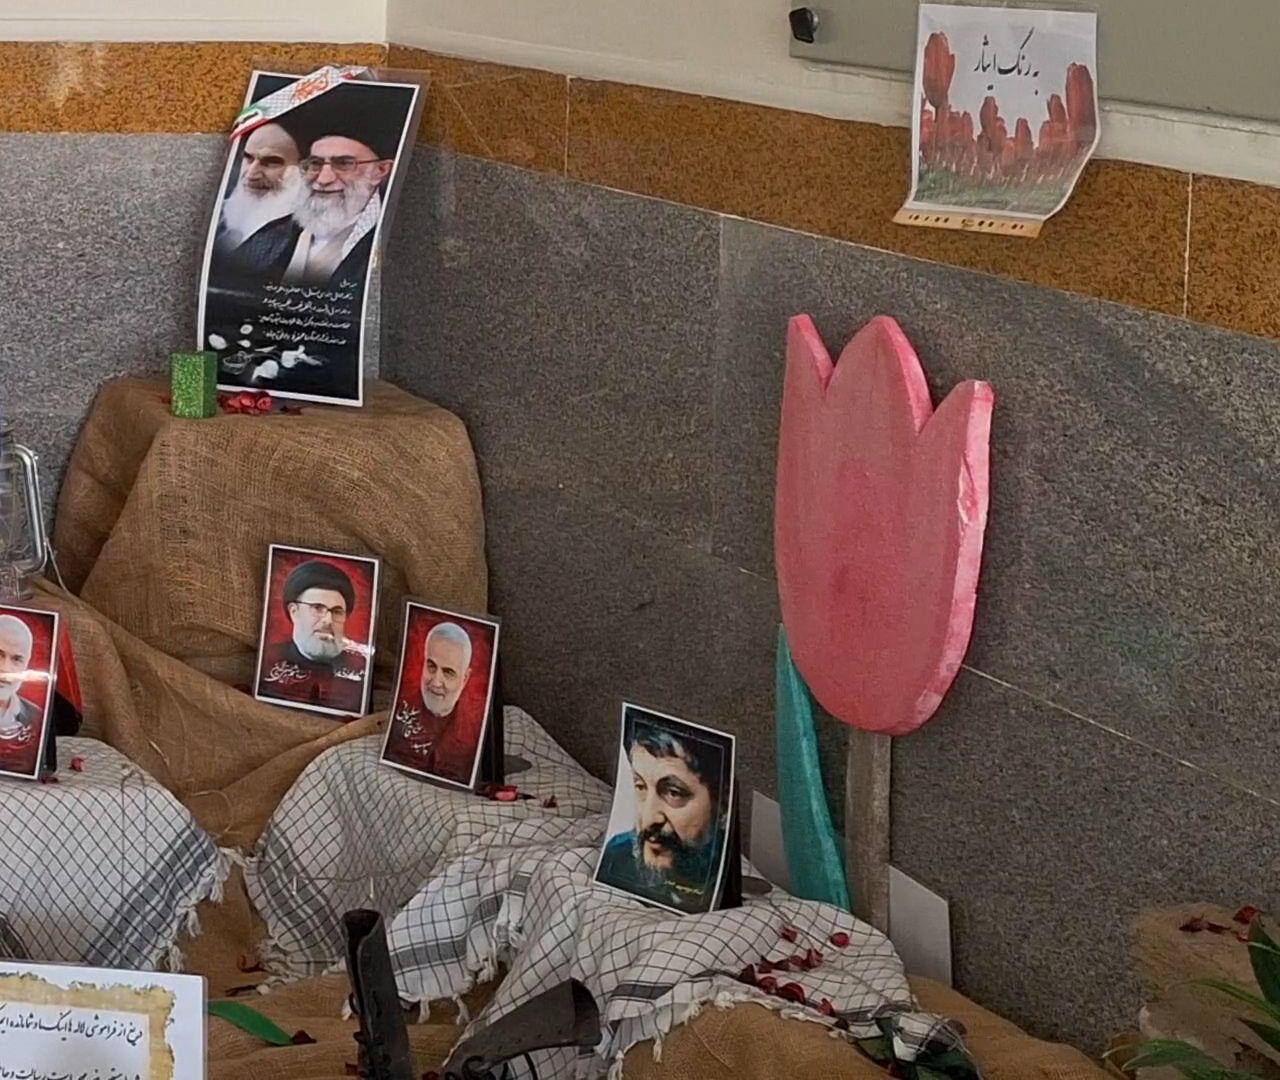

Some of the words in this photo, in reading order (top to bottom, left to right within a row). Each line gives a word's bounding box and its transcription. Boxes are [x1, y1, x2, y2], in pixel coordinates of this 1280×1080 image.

[973, 33, 997, 91] ایثار
[997, 26, 1035, 76] رنگ
[84, 1013, 118, 1040] فراموشی
[117, 1023, 127, 1037] از
[126, 1021, 143, 1047] دریغ
